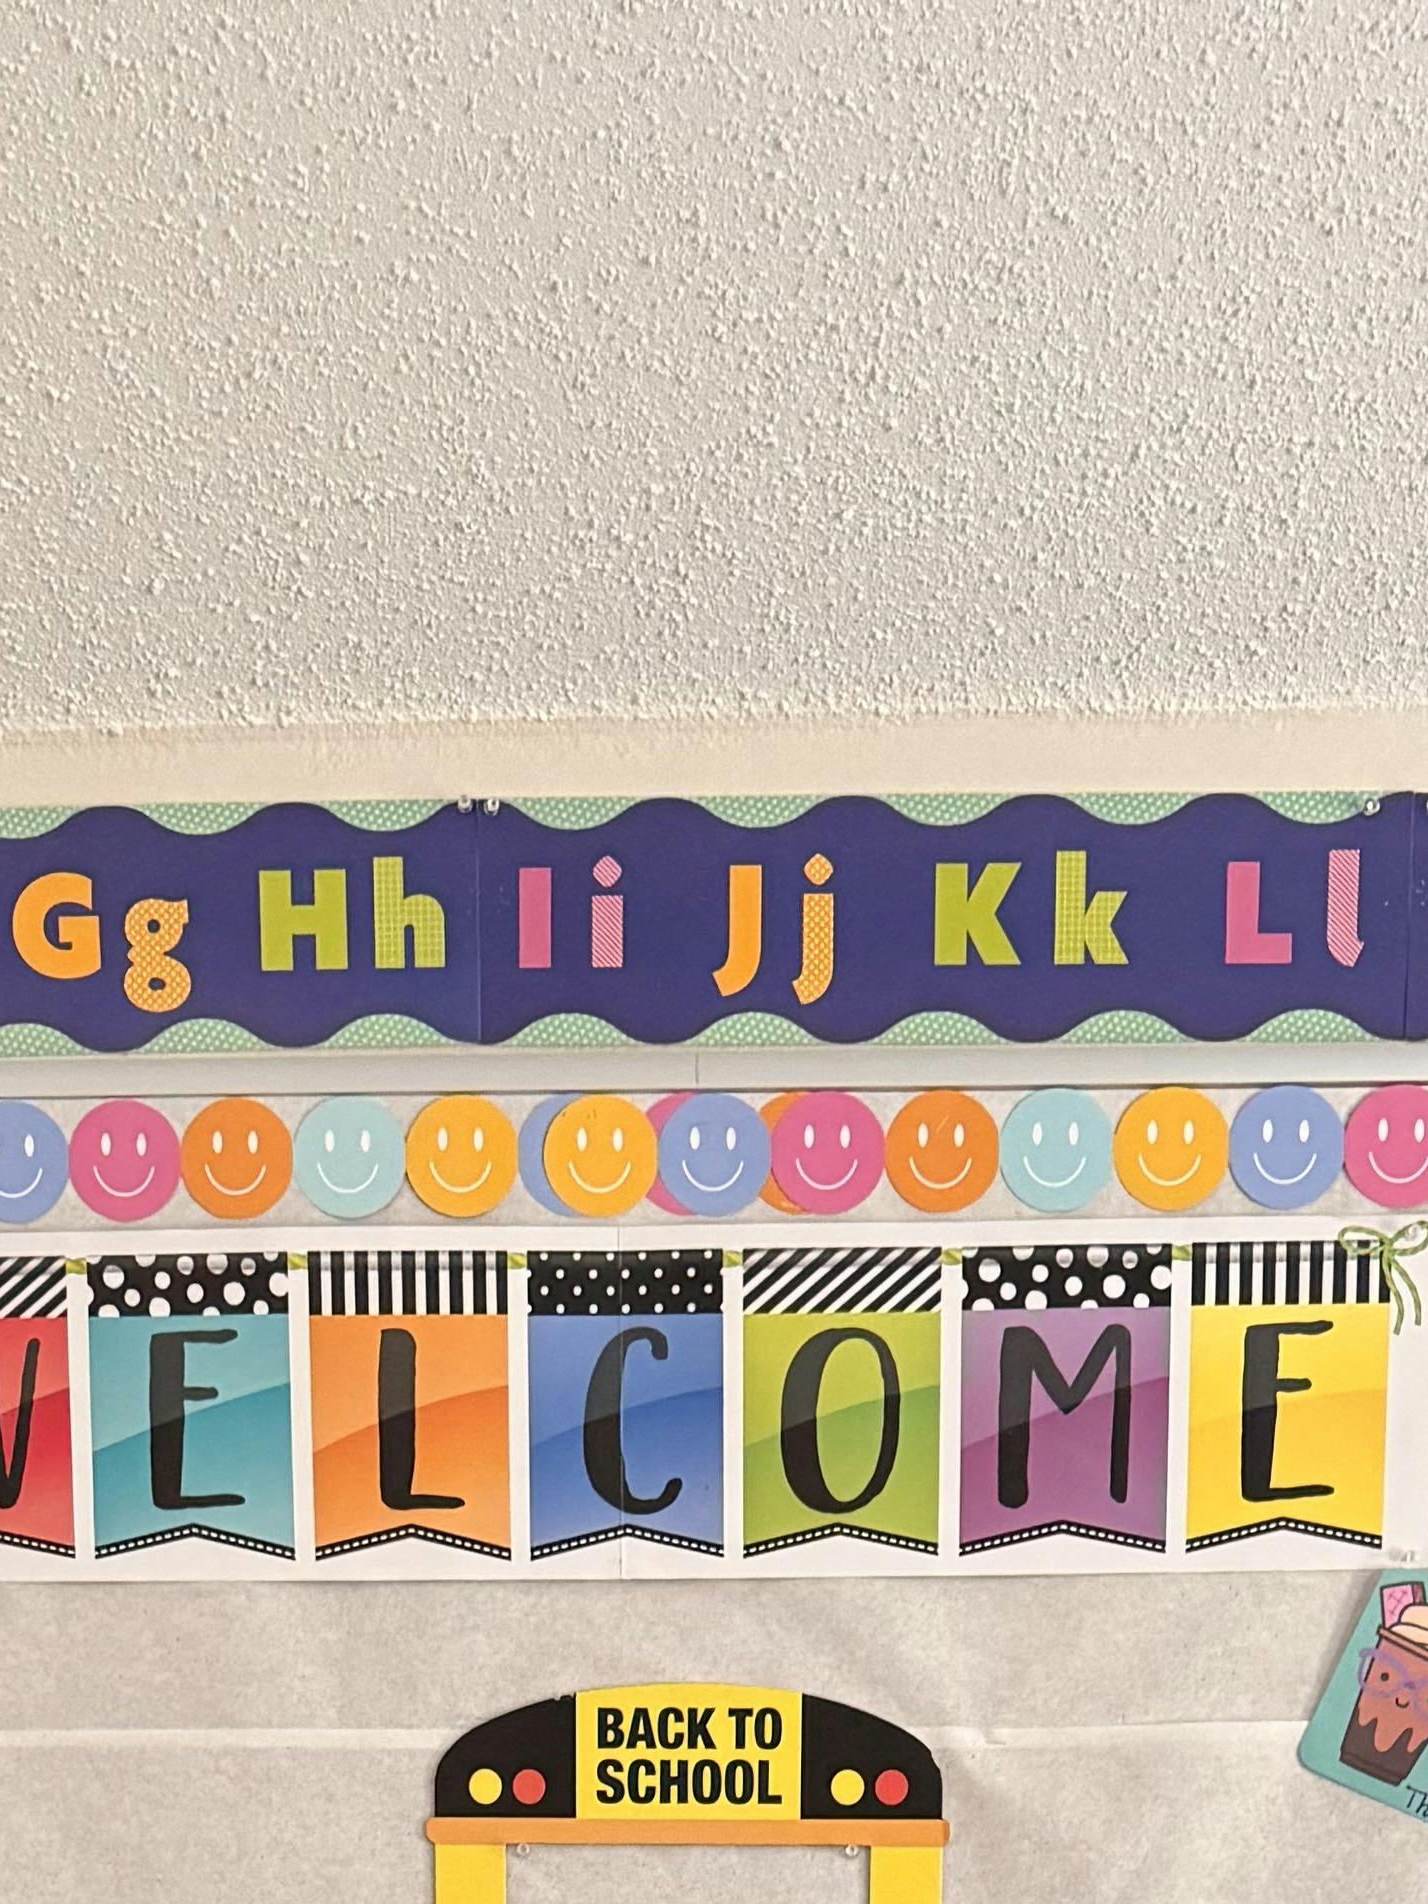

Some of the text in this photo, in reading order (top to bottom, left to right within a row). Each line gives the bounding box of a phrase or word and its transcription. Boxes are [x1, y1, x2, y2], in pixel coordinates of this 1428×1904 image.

[11, 871, 191, 1014] Gg
[258, 858, 444, 971] Hh
[518, 860, 622, 968] Ii
[714, 856, 835, 1005] Jj
[934, 852, 1126, 966] Kk
[1224, 849, 1363, 966] Ll
[596, 1706, 783, 1750] BACK TO
[596, 1758, 783, 1805] SCHOOL
